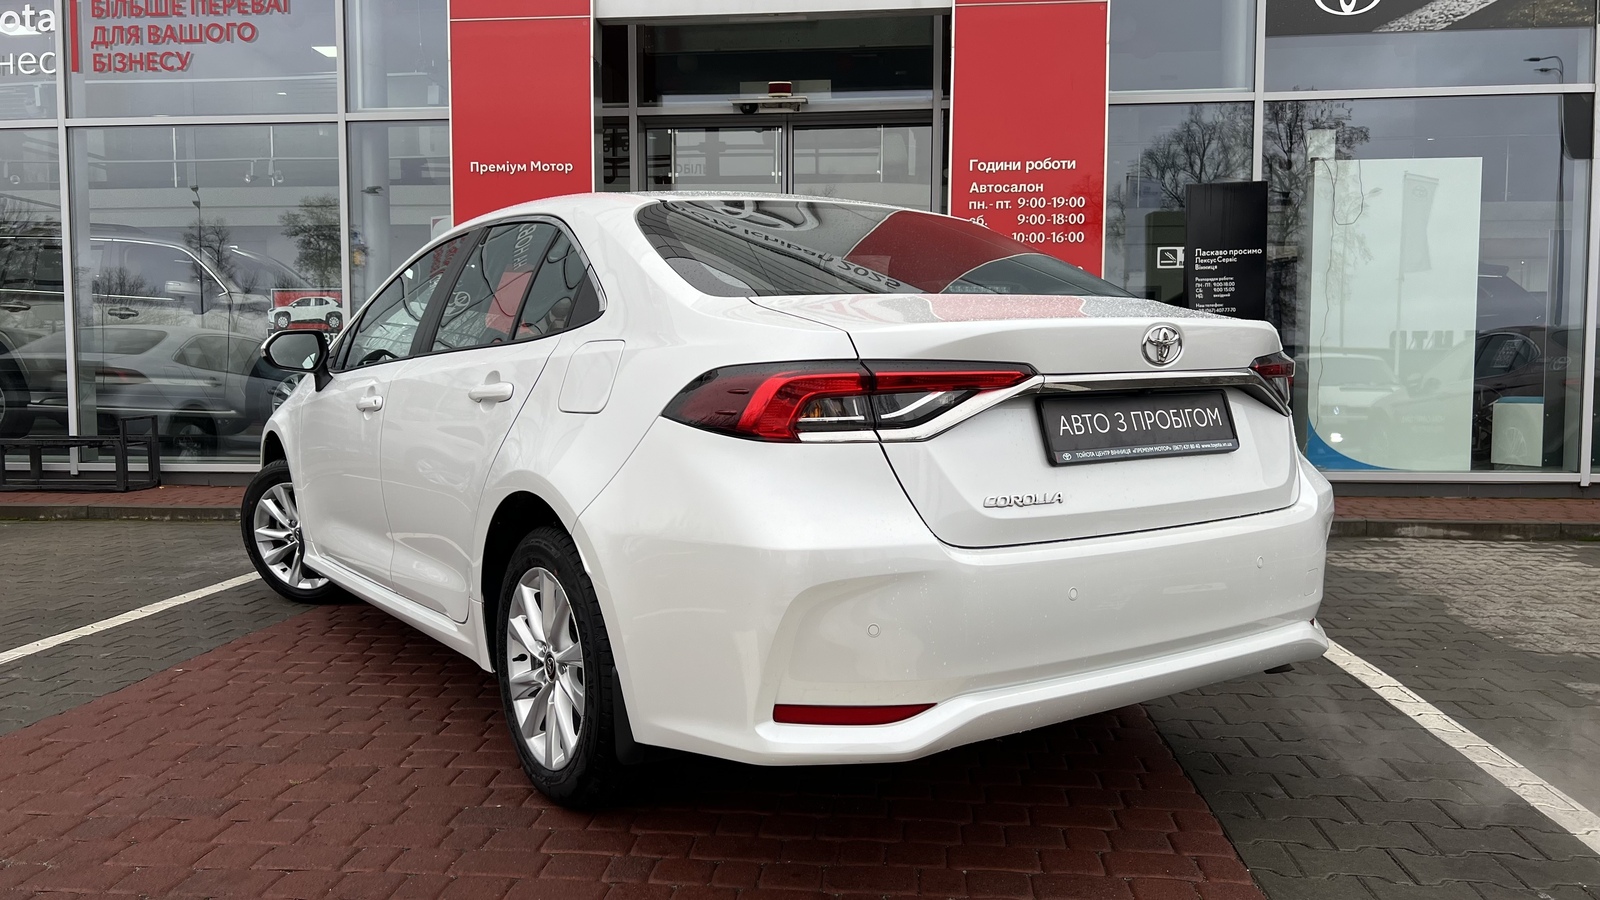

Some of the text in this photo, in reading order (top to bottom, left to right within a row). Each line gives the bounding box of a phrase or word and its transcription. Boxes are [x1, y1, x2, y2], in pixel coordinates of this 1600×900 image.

[91, 0, 184, 18] БІЛЬШЕ
[91, 22, 256, 49] ДЛЯ ВАШОГО
[93, 51, 191, 72] БІЗНЕСУ
[470, 161, 573, 175] Преміум Мотор
[969, 157, 1076, 173] Години роботи
[969, 182, 1044, 193] Автосалон
[1017, 196, 1086, 209] 9:00-19:00
[1017, 213, 1085, 225] 9:00-18:00
[1011, 231, 1085, 243] 10:00-16:00
[1195, 248, 1262, 256] Ласкаво просимо
[1059, 413, 1110, 436] АВТО
[1130, 407, 1223, 431] ПРОБІГОМ
[983, 491, 1063, 508] COROLLA
